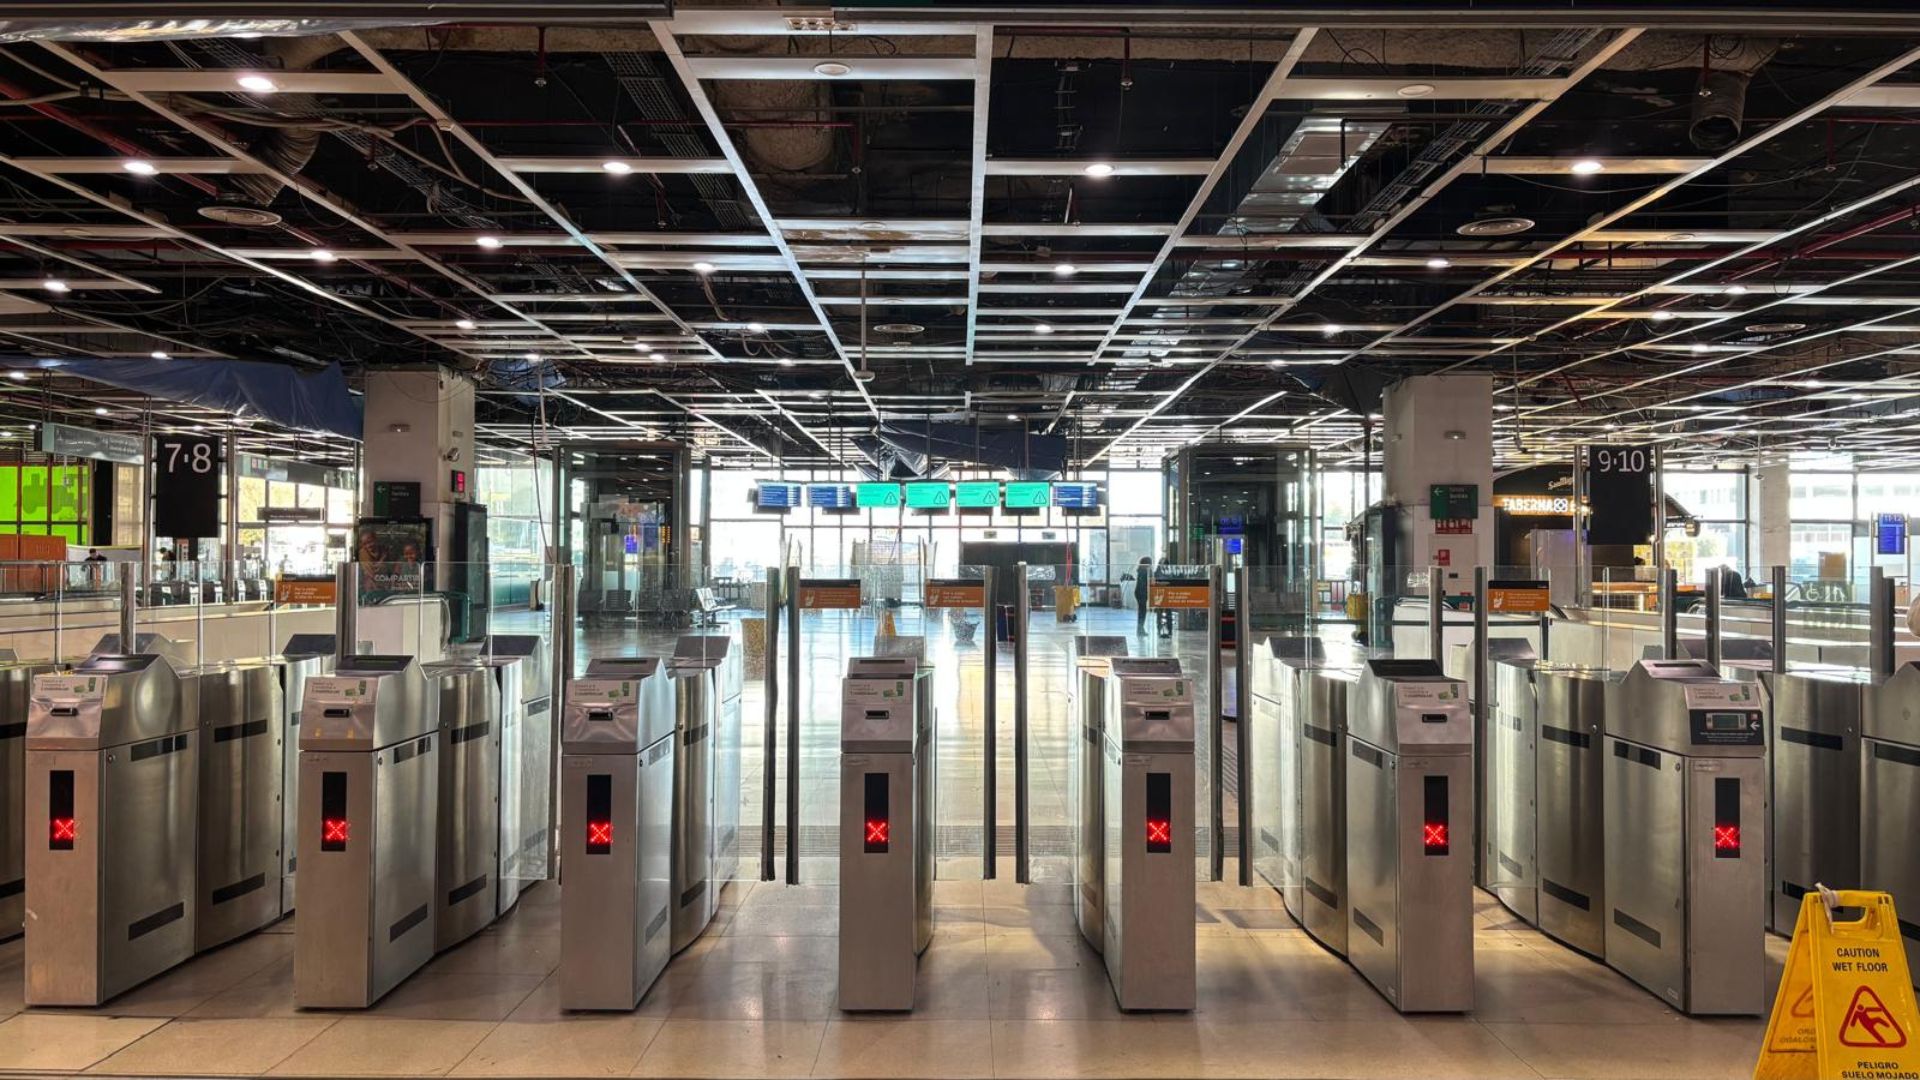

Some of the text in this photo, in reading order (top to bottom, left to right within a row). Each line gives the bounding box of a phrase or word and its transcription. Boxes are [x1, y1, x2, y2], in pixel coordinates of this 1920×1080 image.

[1836, 947, 1880, 958] CAUTION
[1832, 962, 1889, 972] WET FLOOR
[1857, 1061, 1899, 1070] PELIGRO
[1842, 1071, 1919, 1080] SUELO MOJADO
